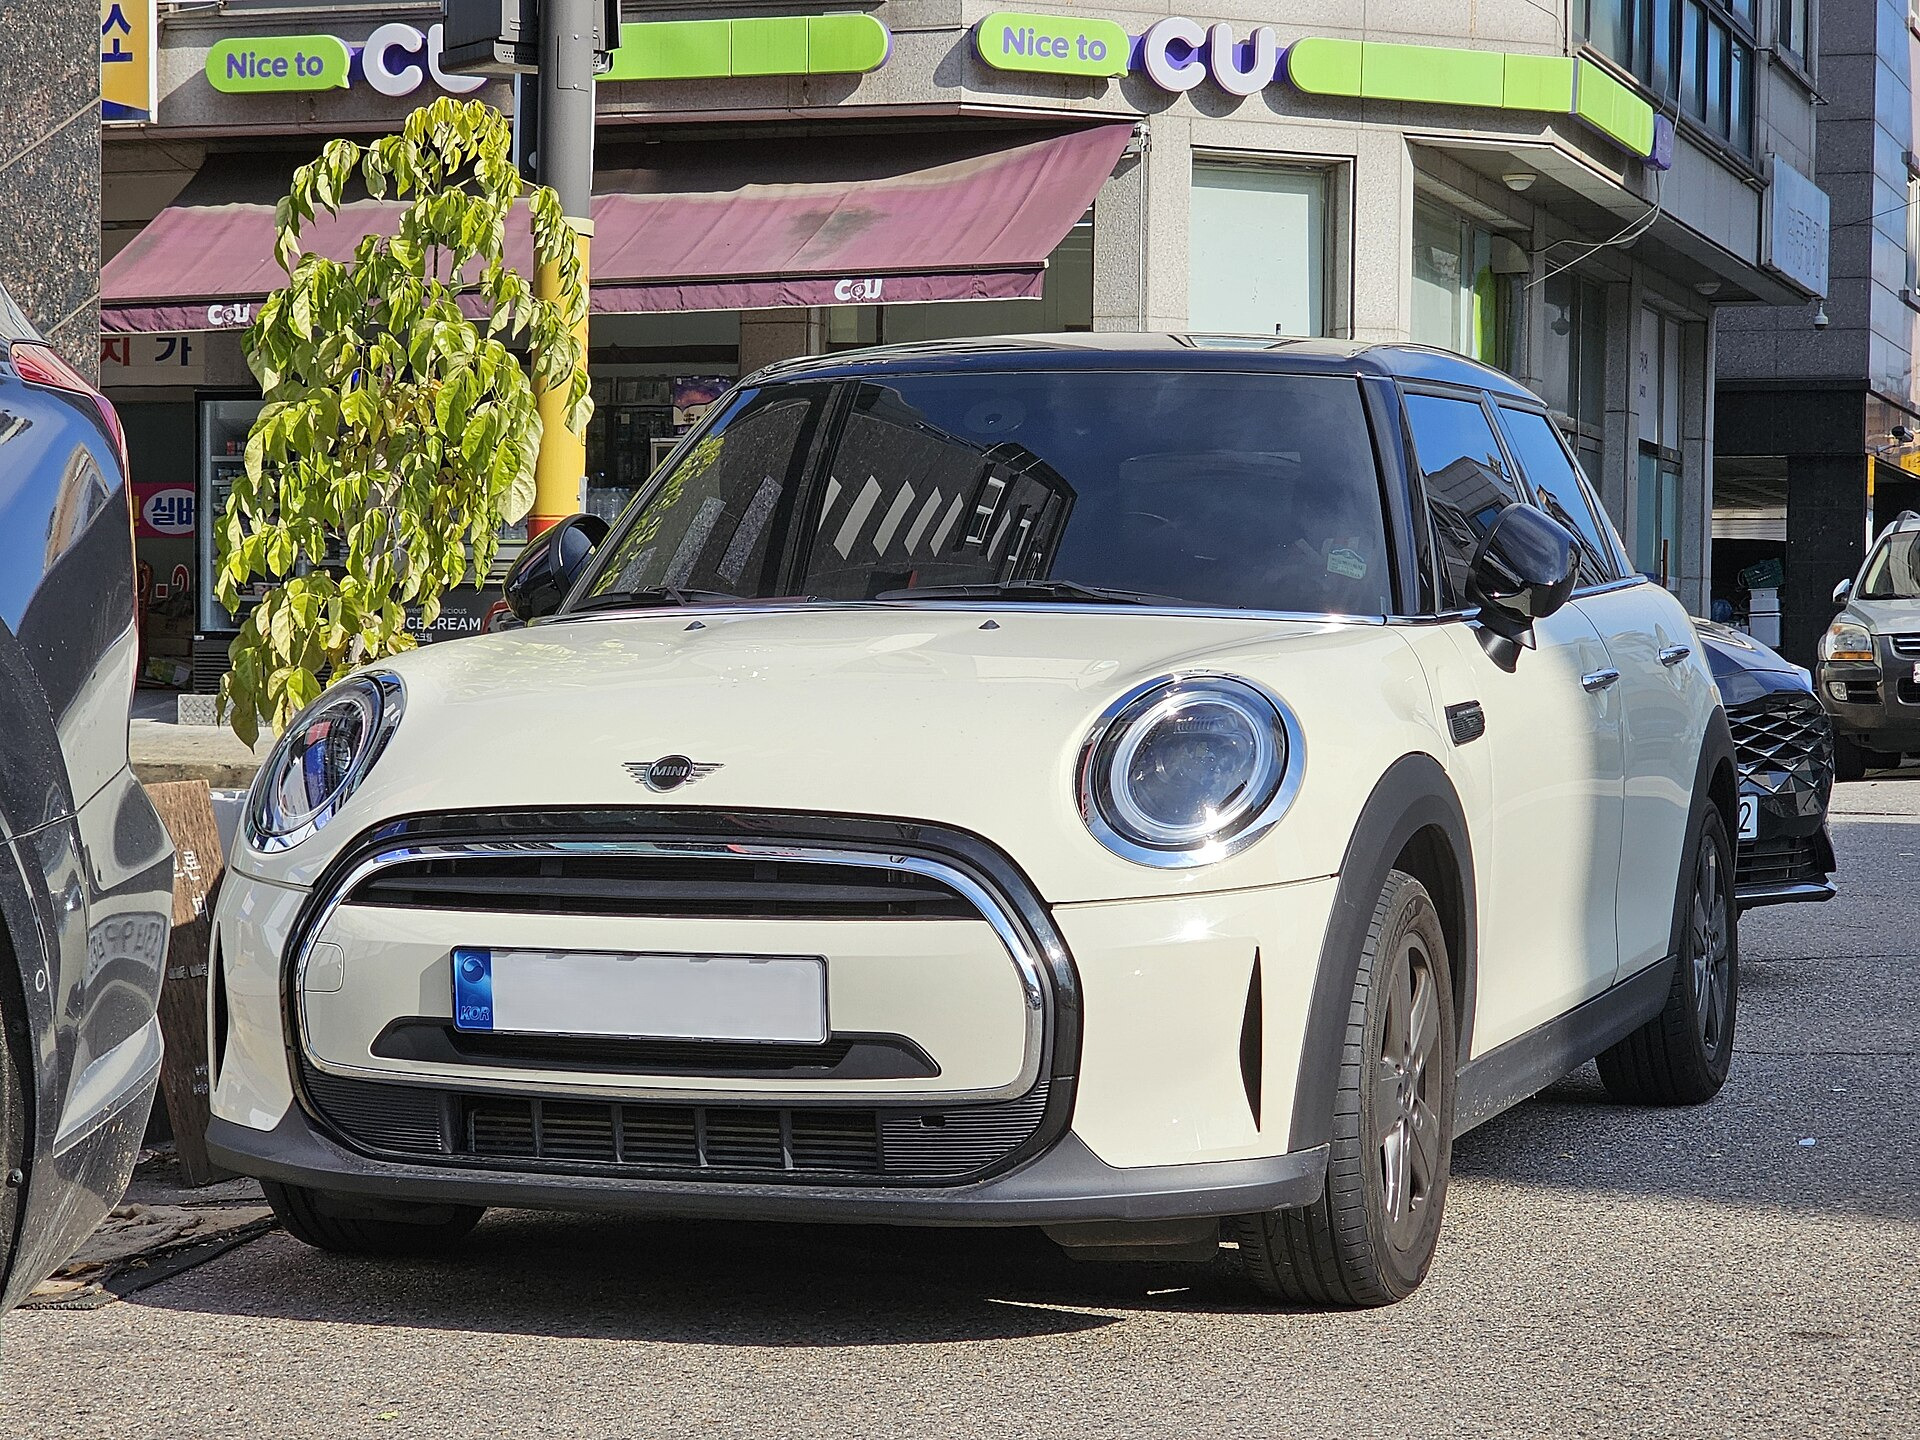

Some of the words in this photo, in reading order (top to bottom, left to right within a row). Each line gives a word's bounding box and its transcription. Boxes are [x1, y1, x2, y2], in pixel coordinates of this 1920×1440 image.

[101, 3, 133, 62] 소
[226, 51, 289, 80] Nice
[293, 51, 325, 77] to
[1002, 26, 1070, 59] Nice
[1076, 34, 1107, 61] to
[1145, 16, 1277, 97] CU
[833, 278, 884, 301] CU
[207, 302, 251, 326] CU
[402, 605, 425, 615] weet
[439, 605, 468, 616] elicious
[402, 616, 482, 632] CEREAM
[651, 765, 689, 777] MINI
[460, 1005, 491, 1021] KOR
